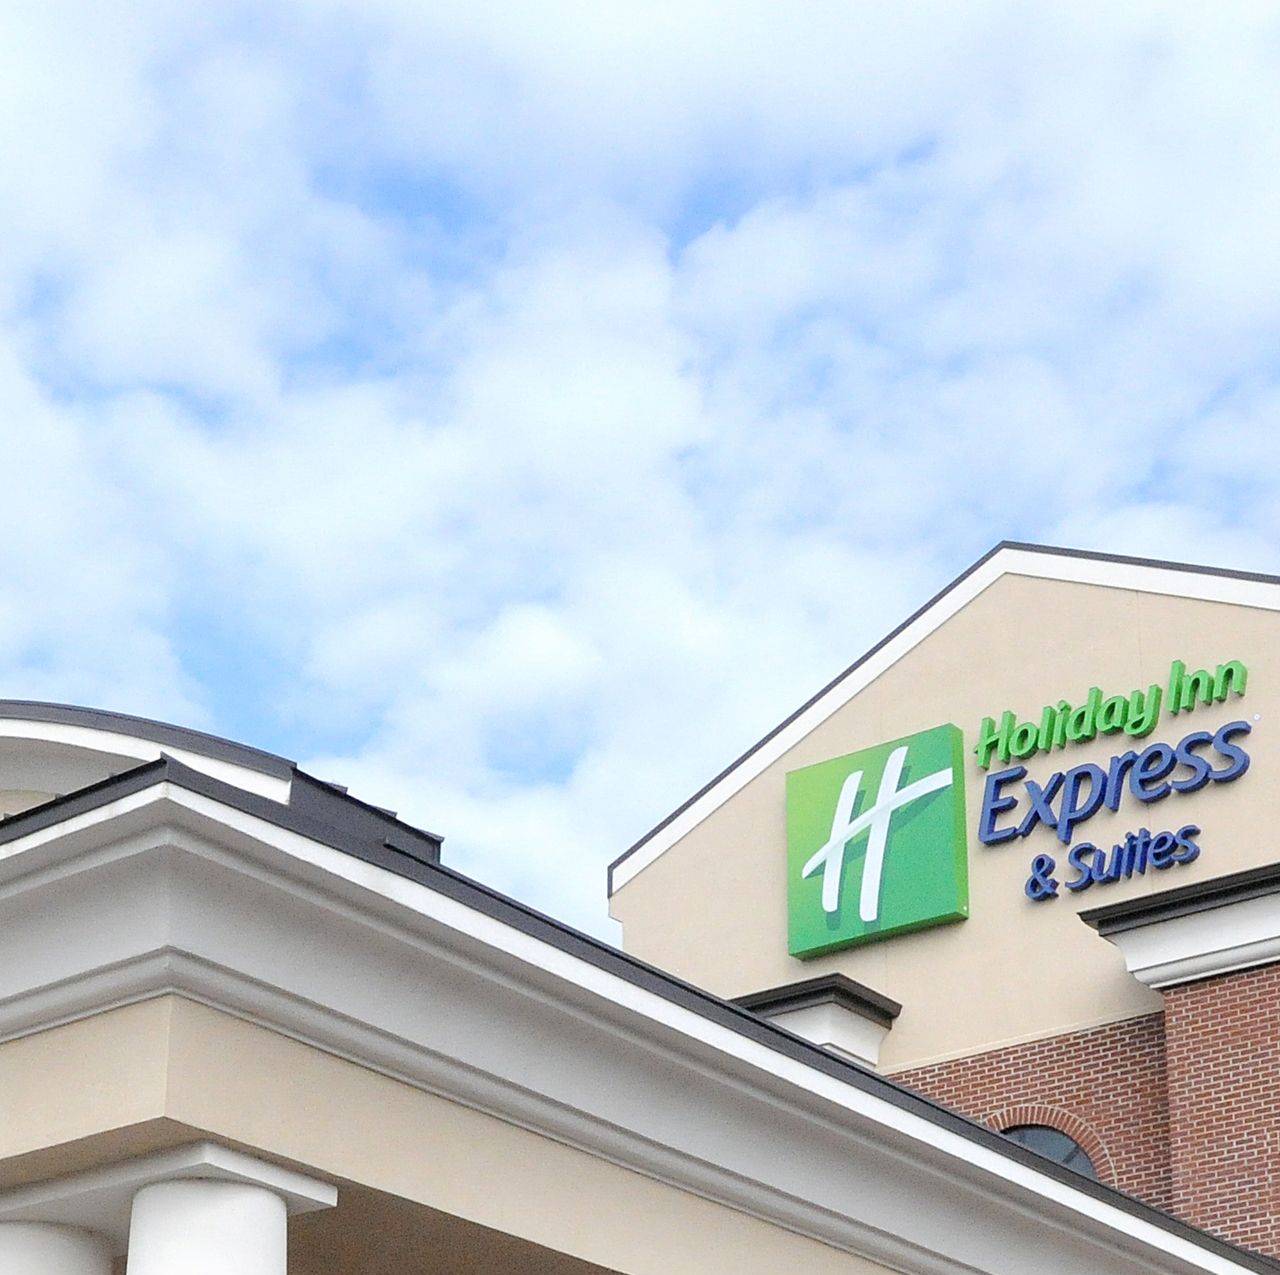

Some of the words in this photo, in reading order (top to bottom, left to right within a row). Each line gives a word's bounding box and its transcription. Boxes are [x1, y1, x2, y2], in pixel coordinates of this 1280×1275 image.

[974, 685, 1163, 770] Holiday
[1169, 659, 1249, 715] Inn
[978, 720, 1252, 846] Express
[1025, 853, 1060, 900] &
[1065, 824, 1201, 892] Suites
